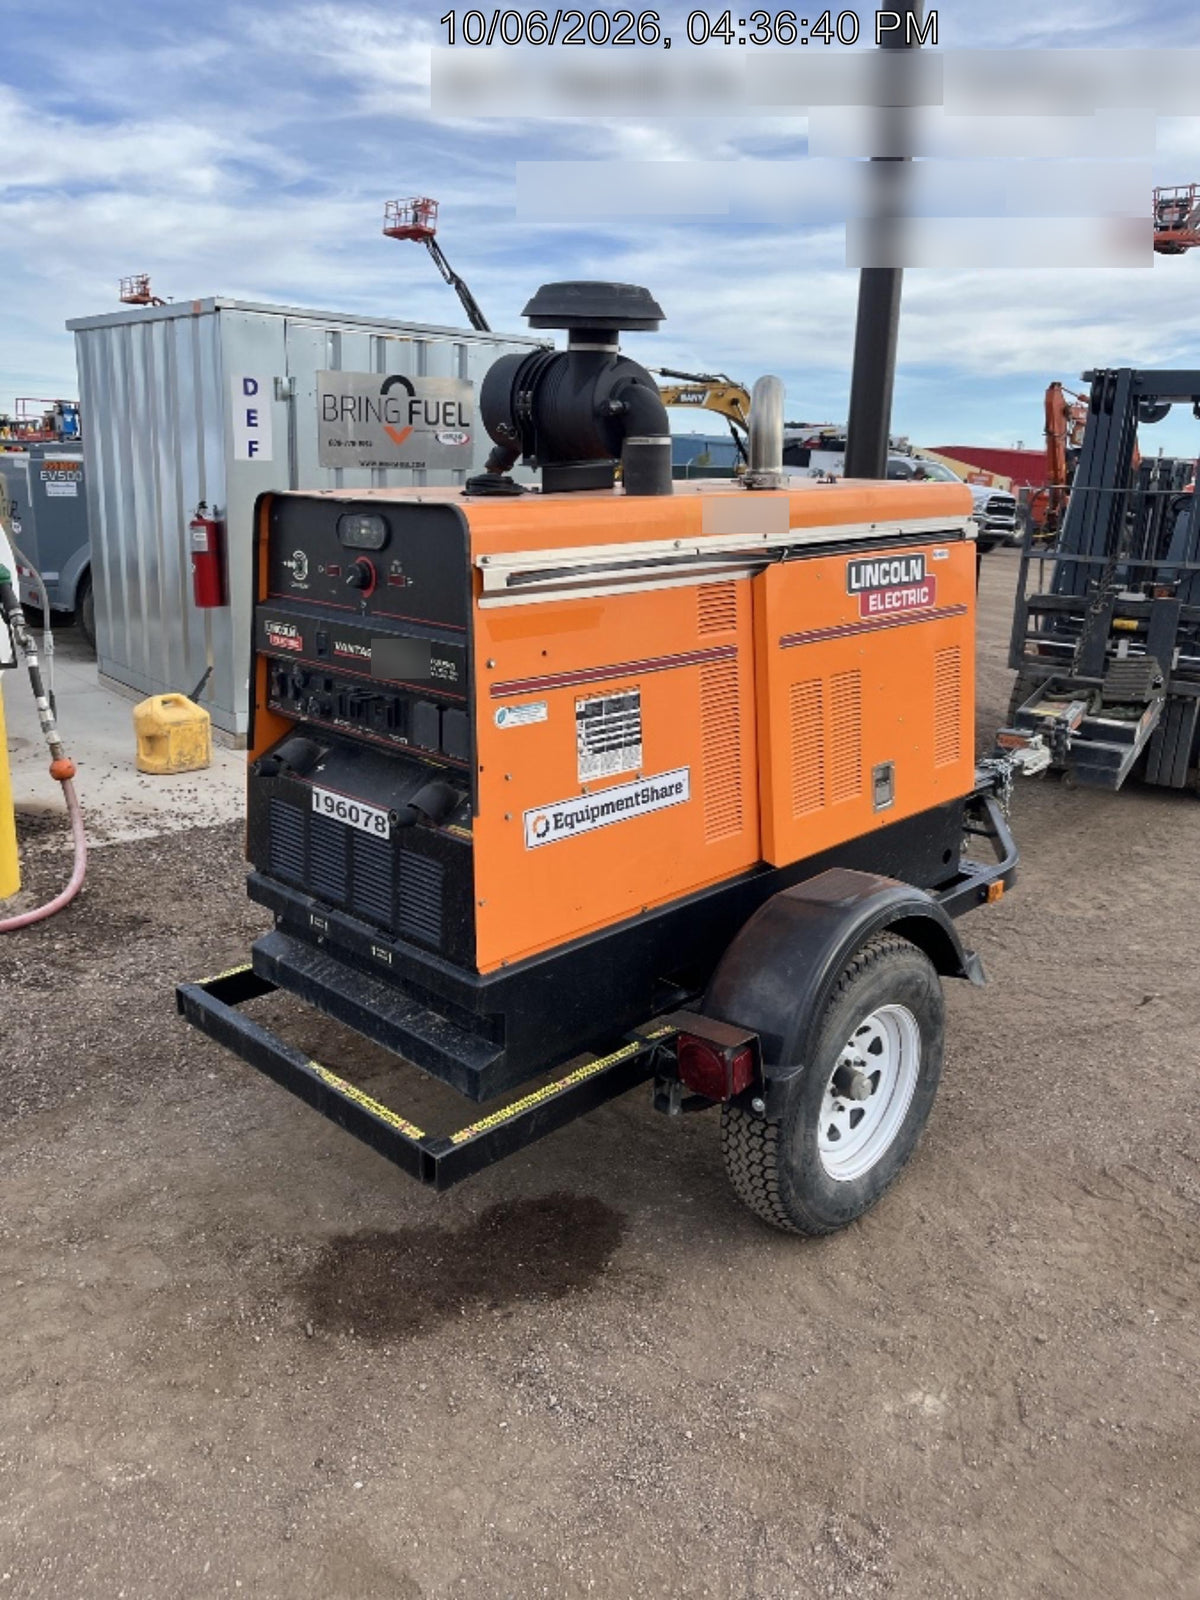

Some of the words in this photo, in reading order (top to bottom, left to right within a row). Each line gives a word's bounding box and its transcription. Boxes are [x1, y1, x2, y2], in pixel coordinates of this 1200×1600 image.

[322, 393, 401, 424] BRING
[408, 399, 470, 428] FUEL
[851, 558, 922, 590] LINCOLN
[868, 586, 929, 612] ELECTRIC
[333, 640, 372, 658] VANTAG
[313, 791, 387, 834] 196078
[552, 781, 684, 830] EquipmentShare
